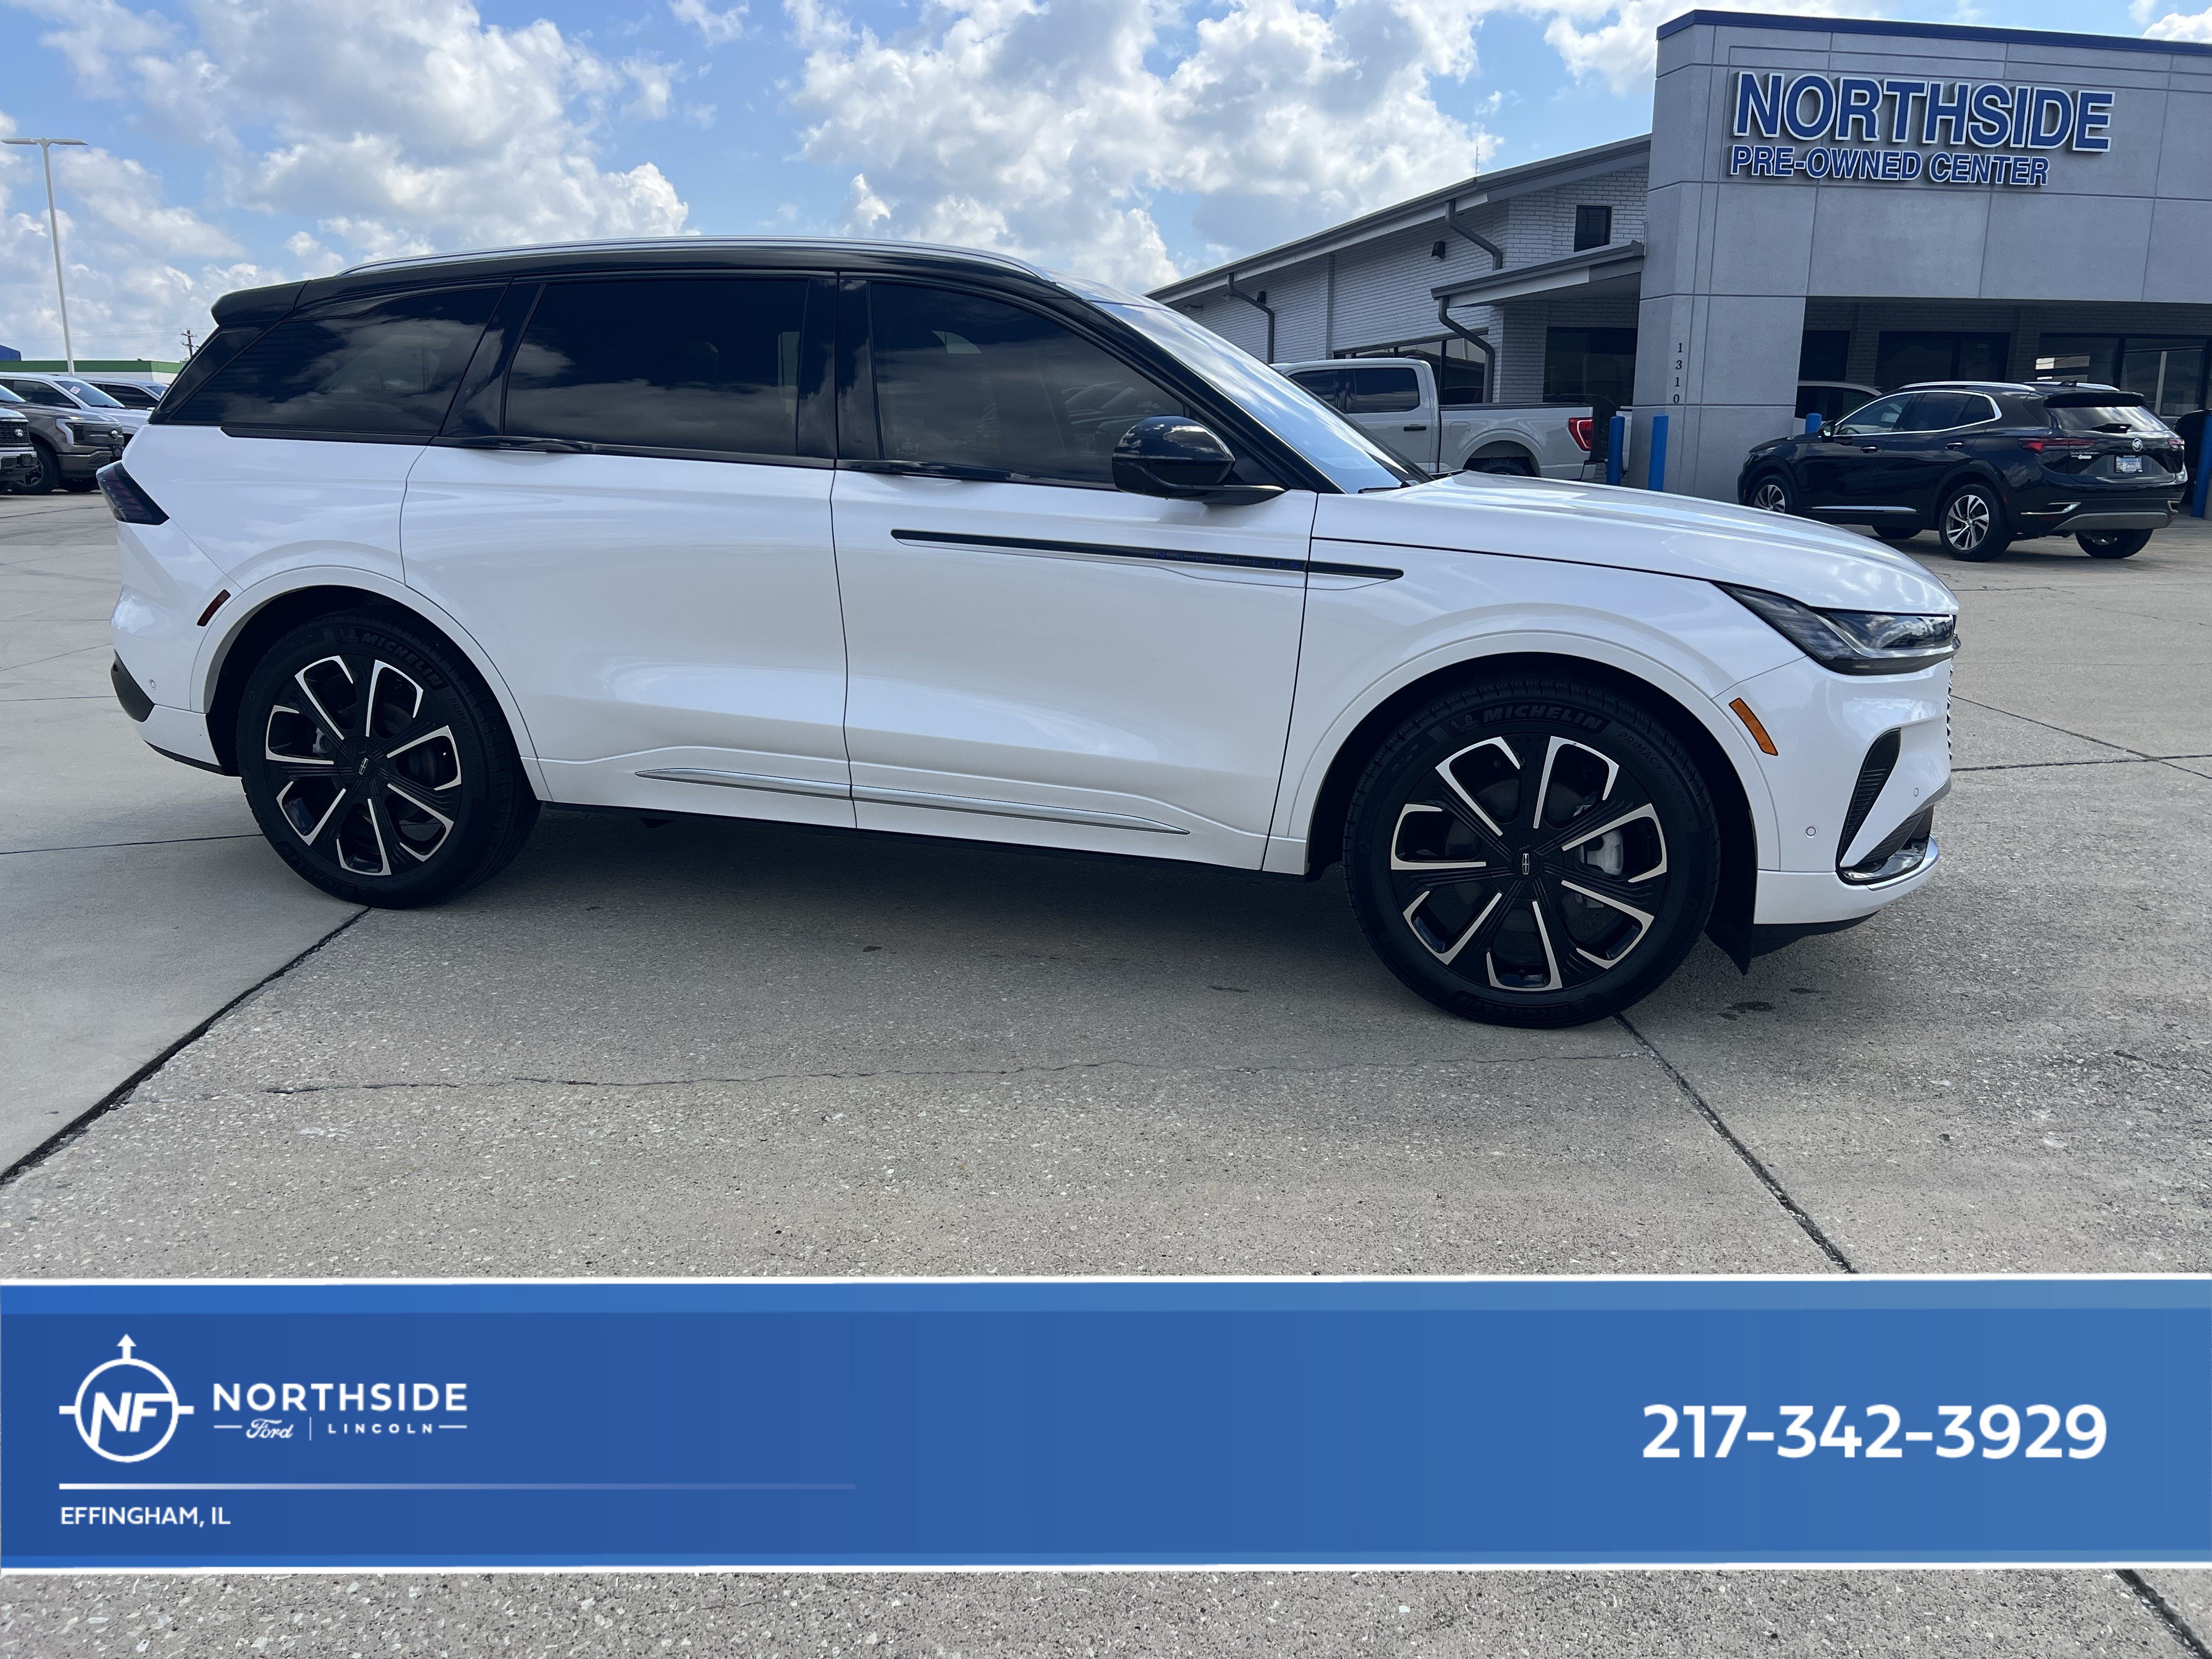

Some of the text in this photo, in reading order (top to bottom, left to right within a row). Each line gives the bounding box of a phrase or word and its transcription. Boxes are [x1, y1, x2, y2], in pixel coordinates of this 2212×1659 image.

[1734, 71, 2115, 152] NORTHSIDE
[1730, 145, 2050, 185] PRE-OWNED CENTER
[1673, 343, 1683, 404] 1310
[1155, 551, 1300, 569] NAUTILUS
[361, 633, 444, 690] MICHELIN
[1483, 704, 1604, 730] MICHELIN
[1617, 731, 1666, 770] PRIMACY
[1665, 774, 1677, 788] ALL
